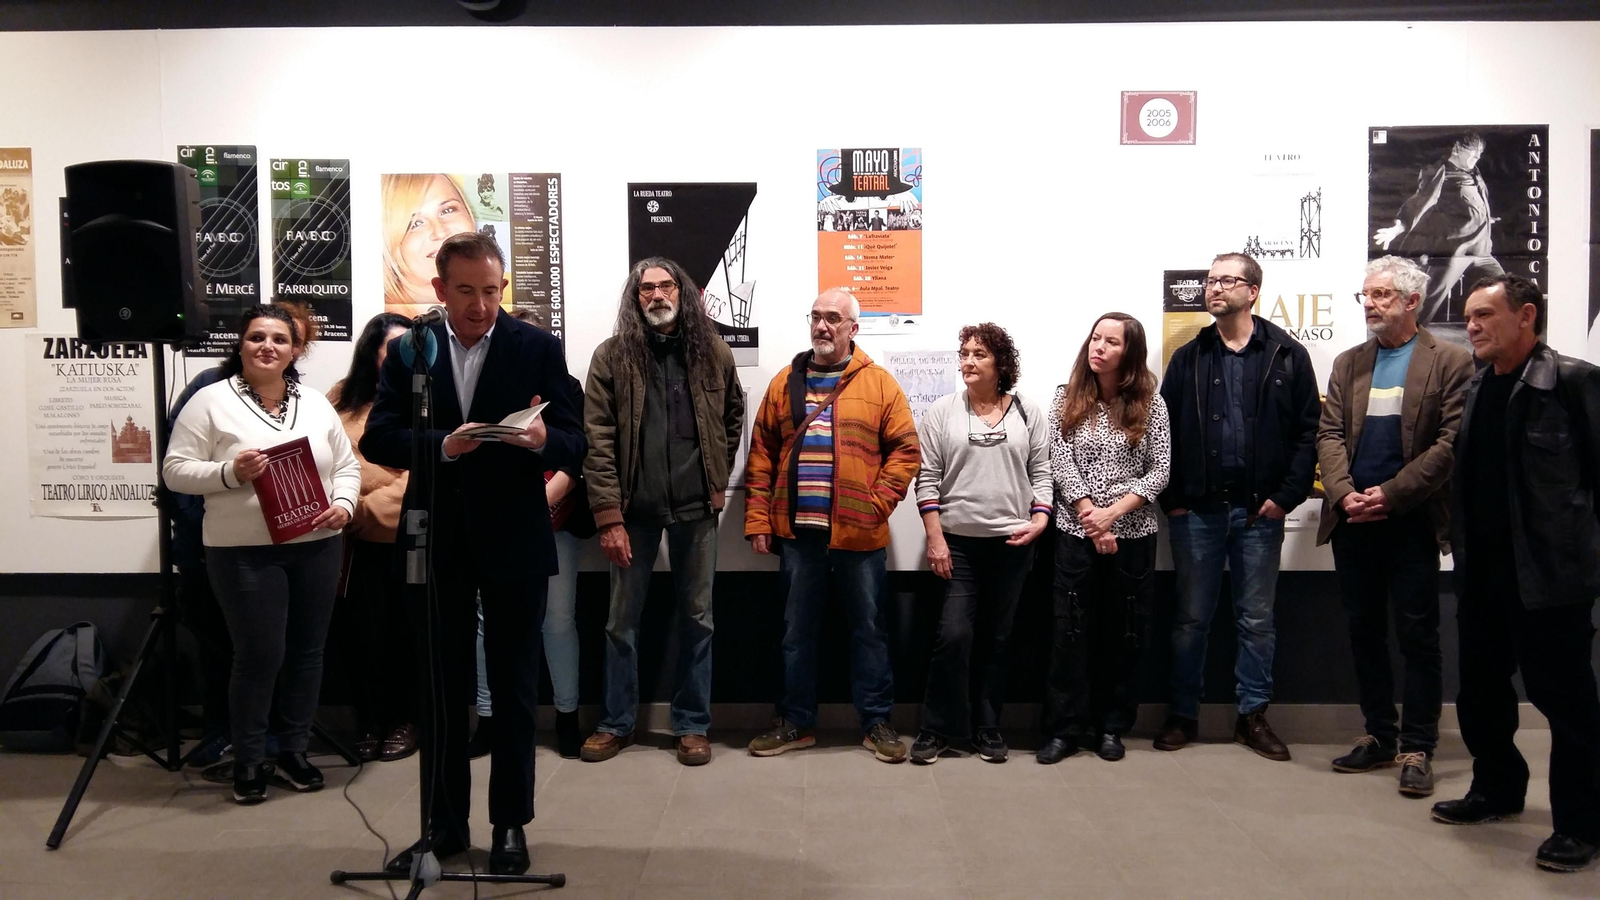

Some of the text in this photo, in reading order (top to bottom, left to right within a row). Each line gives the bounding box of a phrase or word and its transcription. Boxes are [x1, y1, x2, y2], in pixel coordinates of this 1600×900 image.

[1147, 109, 1171, 117] 2005
[180, 146, 196, 157] cir
[272, 159, 288, 170] cir
[853, 150, 888, 172] MAYO
[272, 181, 290, 190] tos
[853, 176, 889, 190] TEATRAL
[1527, 134, 1541, 250] ANTONIO
[548, 178, 560, 264] ESPECTADORES
[278, 283, 348, 297] FARRUQUITO
[550, 266, 561, 309] 600.000
[551, 312, 561, 327] DE
[1254, 294, 1334, 331] IAJE
[1289, 328, 1333, 341] NASO
[51, 363, 140, 377] "KATIUSKA"
[41, 484, 156, 501] TEATRO LIRICO ANDALUZ
[275, 501, 320, 524] TEATRO
